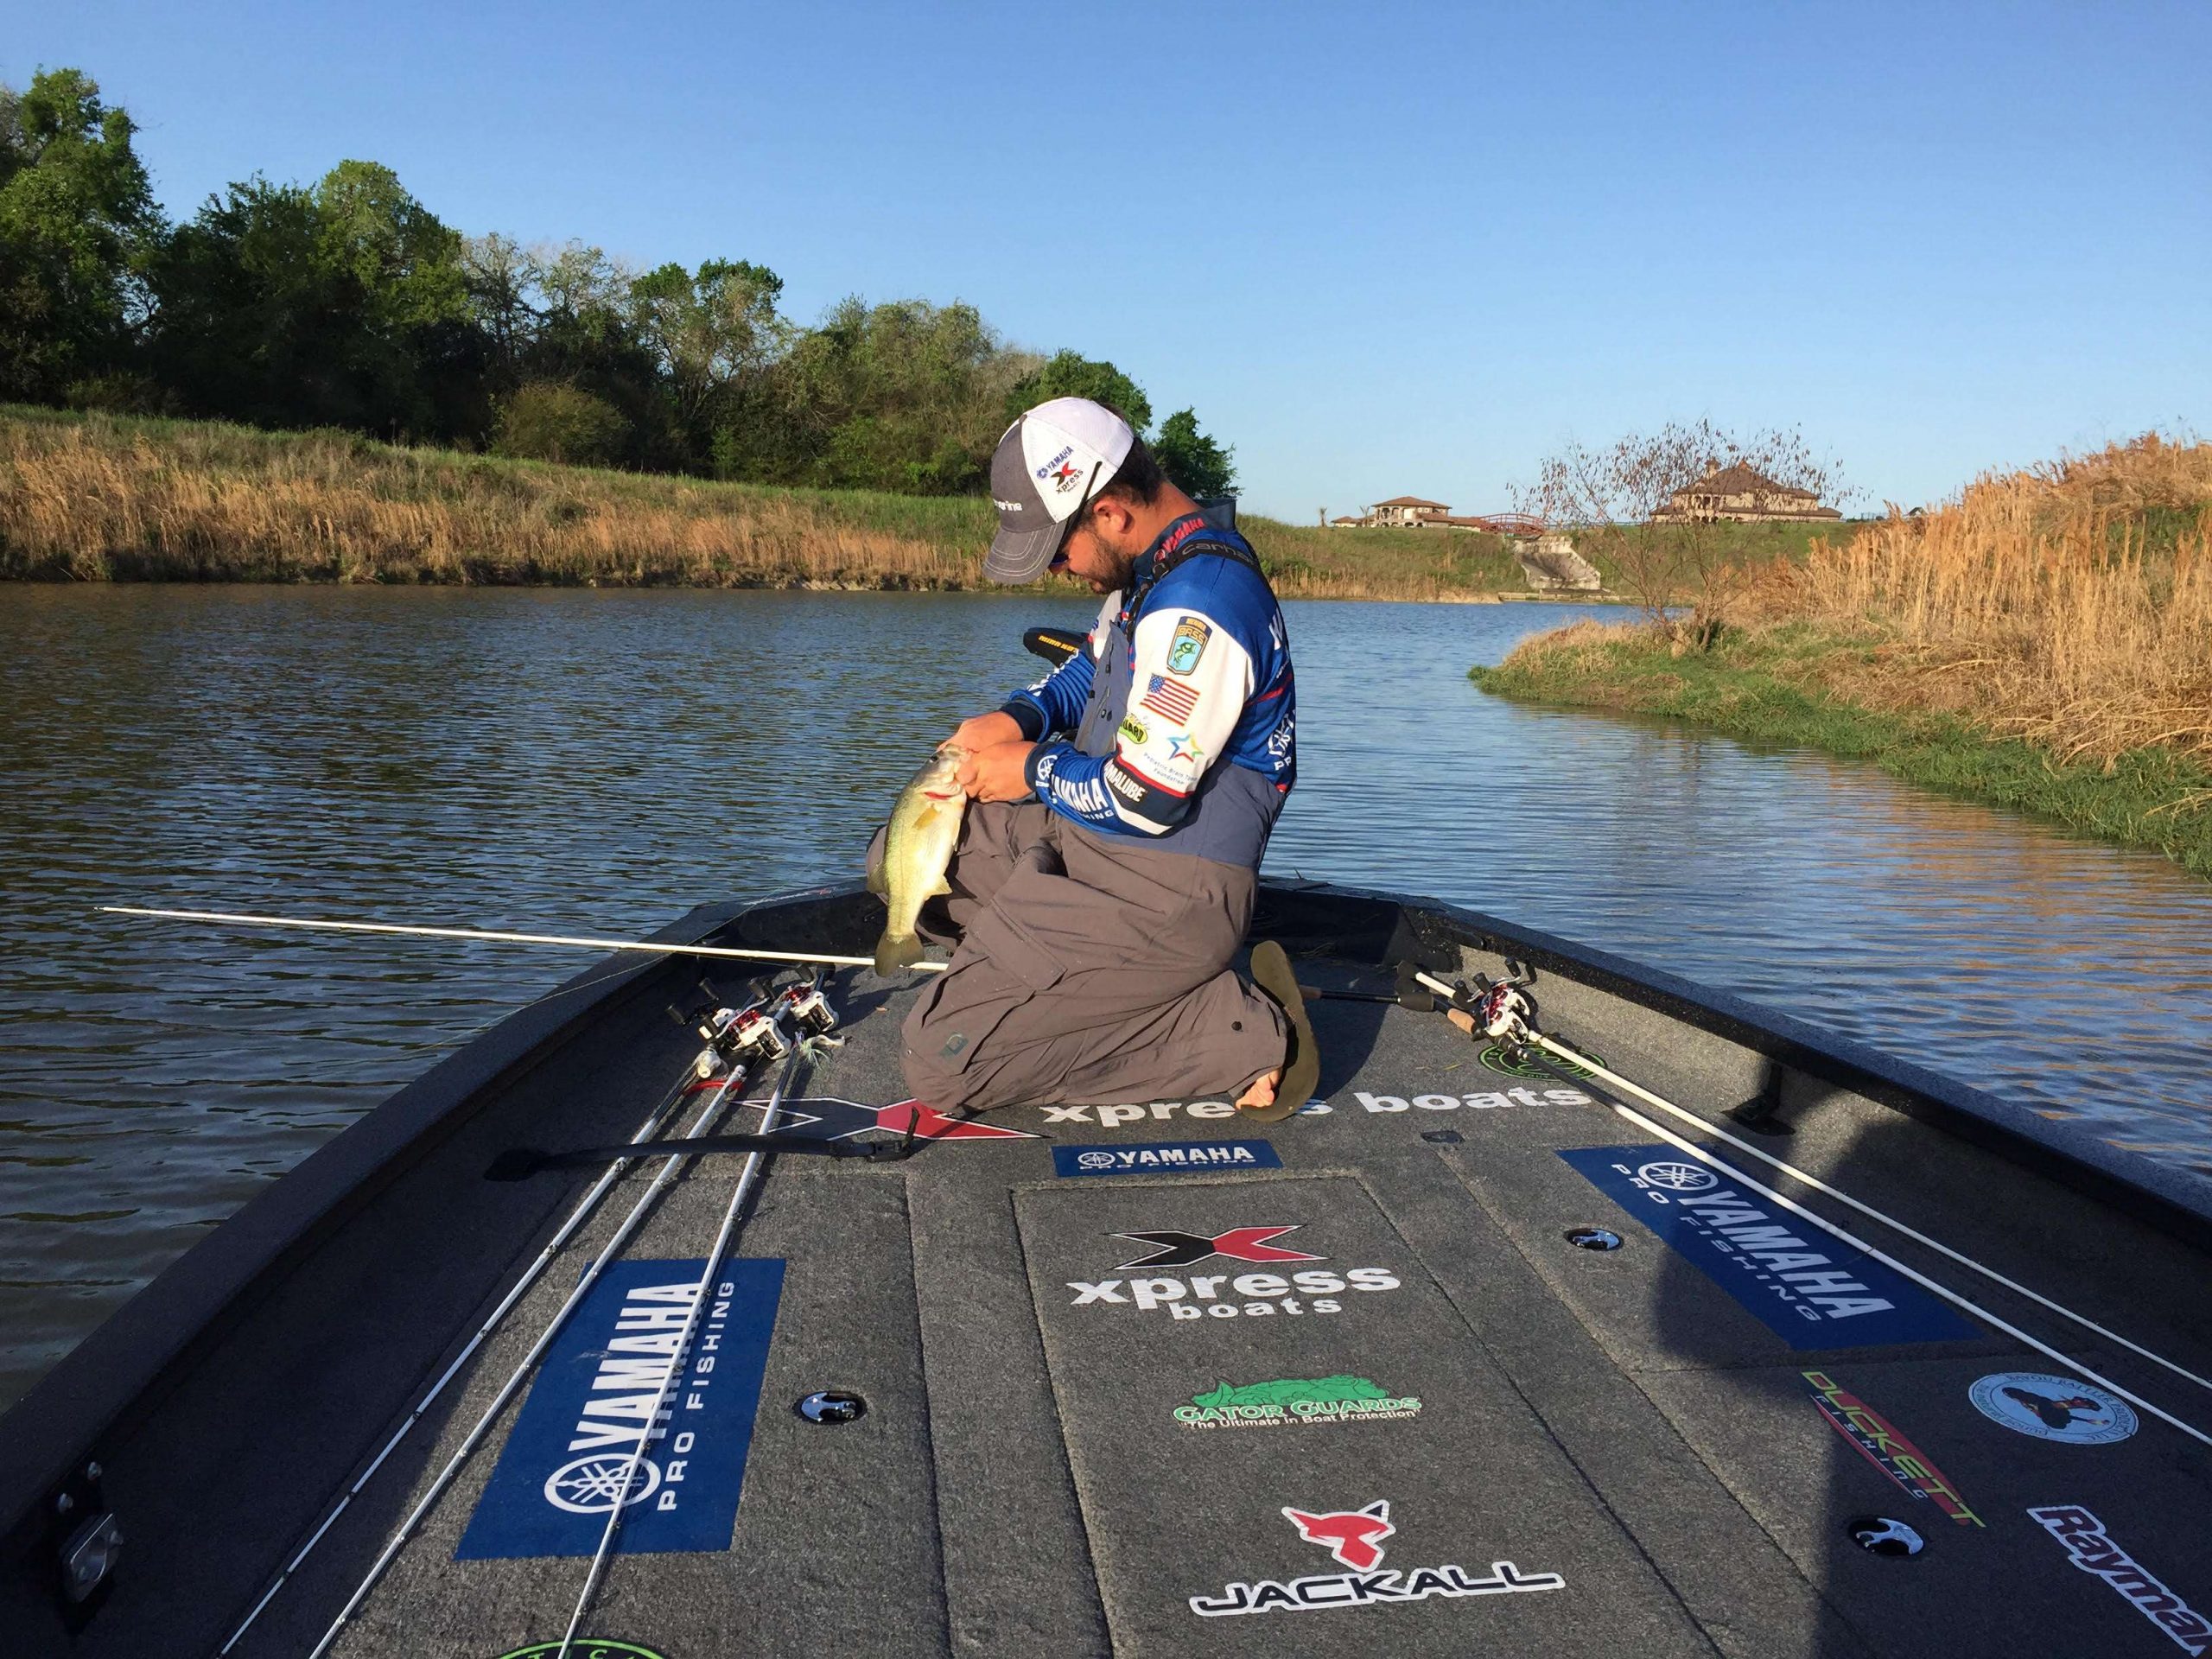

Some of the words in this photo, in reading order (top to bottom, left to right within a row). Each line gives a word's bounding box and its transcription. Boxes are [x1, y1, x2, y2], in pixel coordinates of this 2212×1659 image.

[1046, 446, 1074, 471] YAMAHA
[1056, 469, 1084, 494] xpress
[1177, 627, 1205, 645] BASS
[1121, 719, 1145, 742] UARD
[1039, 1100, 1333, 1128] xpres
[1353, 1086, 1592, 1113] boats
[1116, 1147, 1255, 1165] YAMAHA
[1611, 1164, 1669, 1204] PRO
[1680, 1217, 1821, 1321] FISHING
[1677, 1191, 1896, 1319] YAMAHA
[1066, 1268, 1401, 1309] xpress
[1168, 1297, 1342, 1320] boats
[568, 1282, 706, 1452] YAMAHA
[657, 1432, 695, 1511] PRO
[685, 1281, 734, 1410] FISHING
[1173, 1405, 1287, 1422] GATOR
[1290, 1397, 1422, 1416] GUARDS
[1219, 1418, 1281, 1427] Ultimate
[1301, 1414, 1337, 1424] Boat
[1801, 1371, 1986, 1528] DUCKETT
[1192, 1562, 1562, 1613] JACKALL
